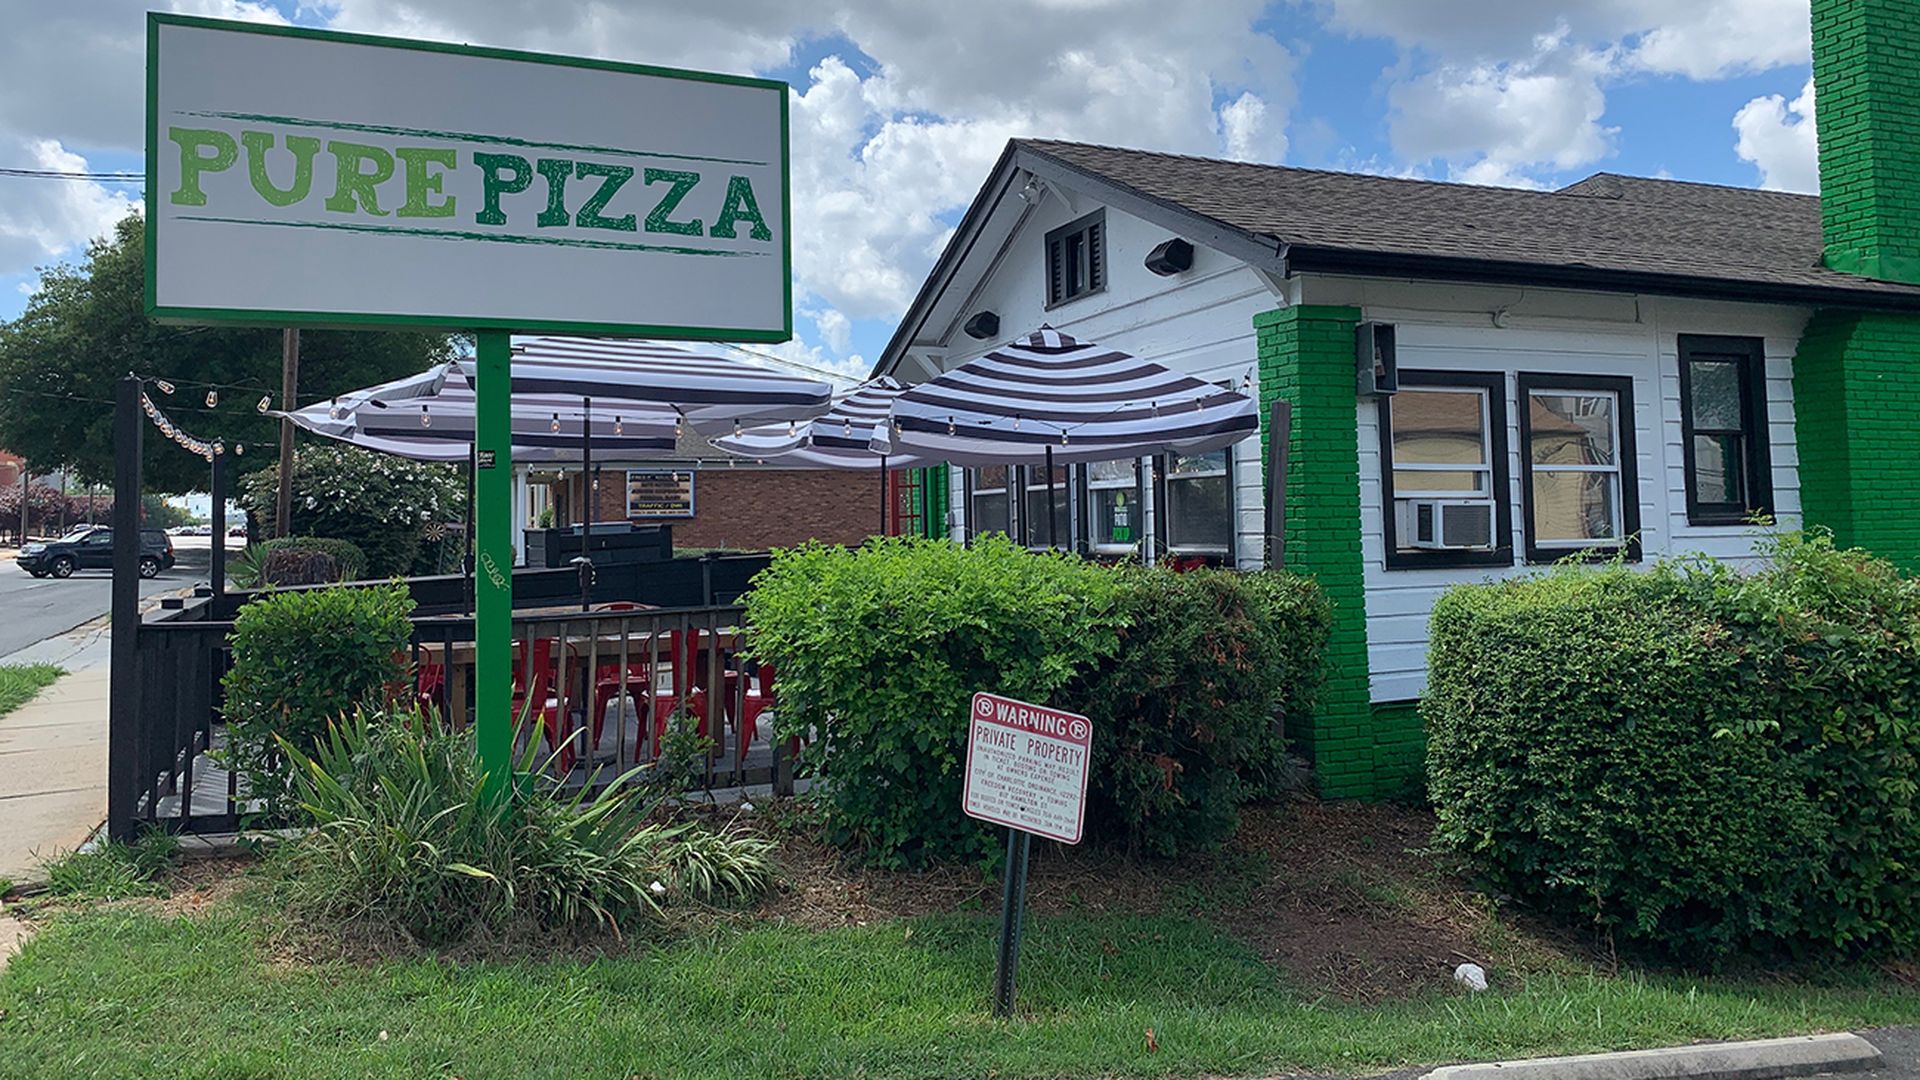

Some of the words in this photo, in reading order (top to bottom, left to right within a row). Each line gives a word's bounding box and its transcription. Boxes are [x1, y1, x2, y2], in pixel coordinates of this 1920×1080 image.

[168, 126, 457, 218] PURE
[473, 151, 772, 242] PIZZA
[996, 703, 1066, 735] WARNING
[976, 726, 1016, 750] PRIVATE
[1027, 738, 1082, 766] PROPERTY
[983, 752, 989, 761] IN
[1048, 769, 1070, 781] TOWING
[1017, 754, 1041, 767] PARKING
[1044, 760, 1056, 770] MAY
[1057, 764, 1079, 776] RESULT
[973, 767, 986, 777] CITY
[996, 773, 1025, 787] CHARLOTTE
[1029, 771, 1055, 784] EXPENSE
[1007, 784, 1036, 799] RECOVERY
[1046, 794, 1068, 807] TOWING
[1010, 793, 1038, 807] HAMILTON
